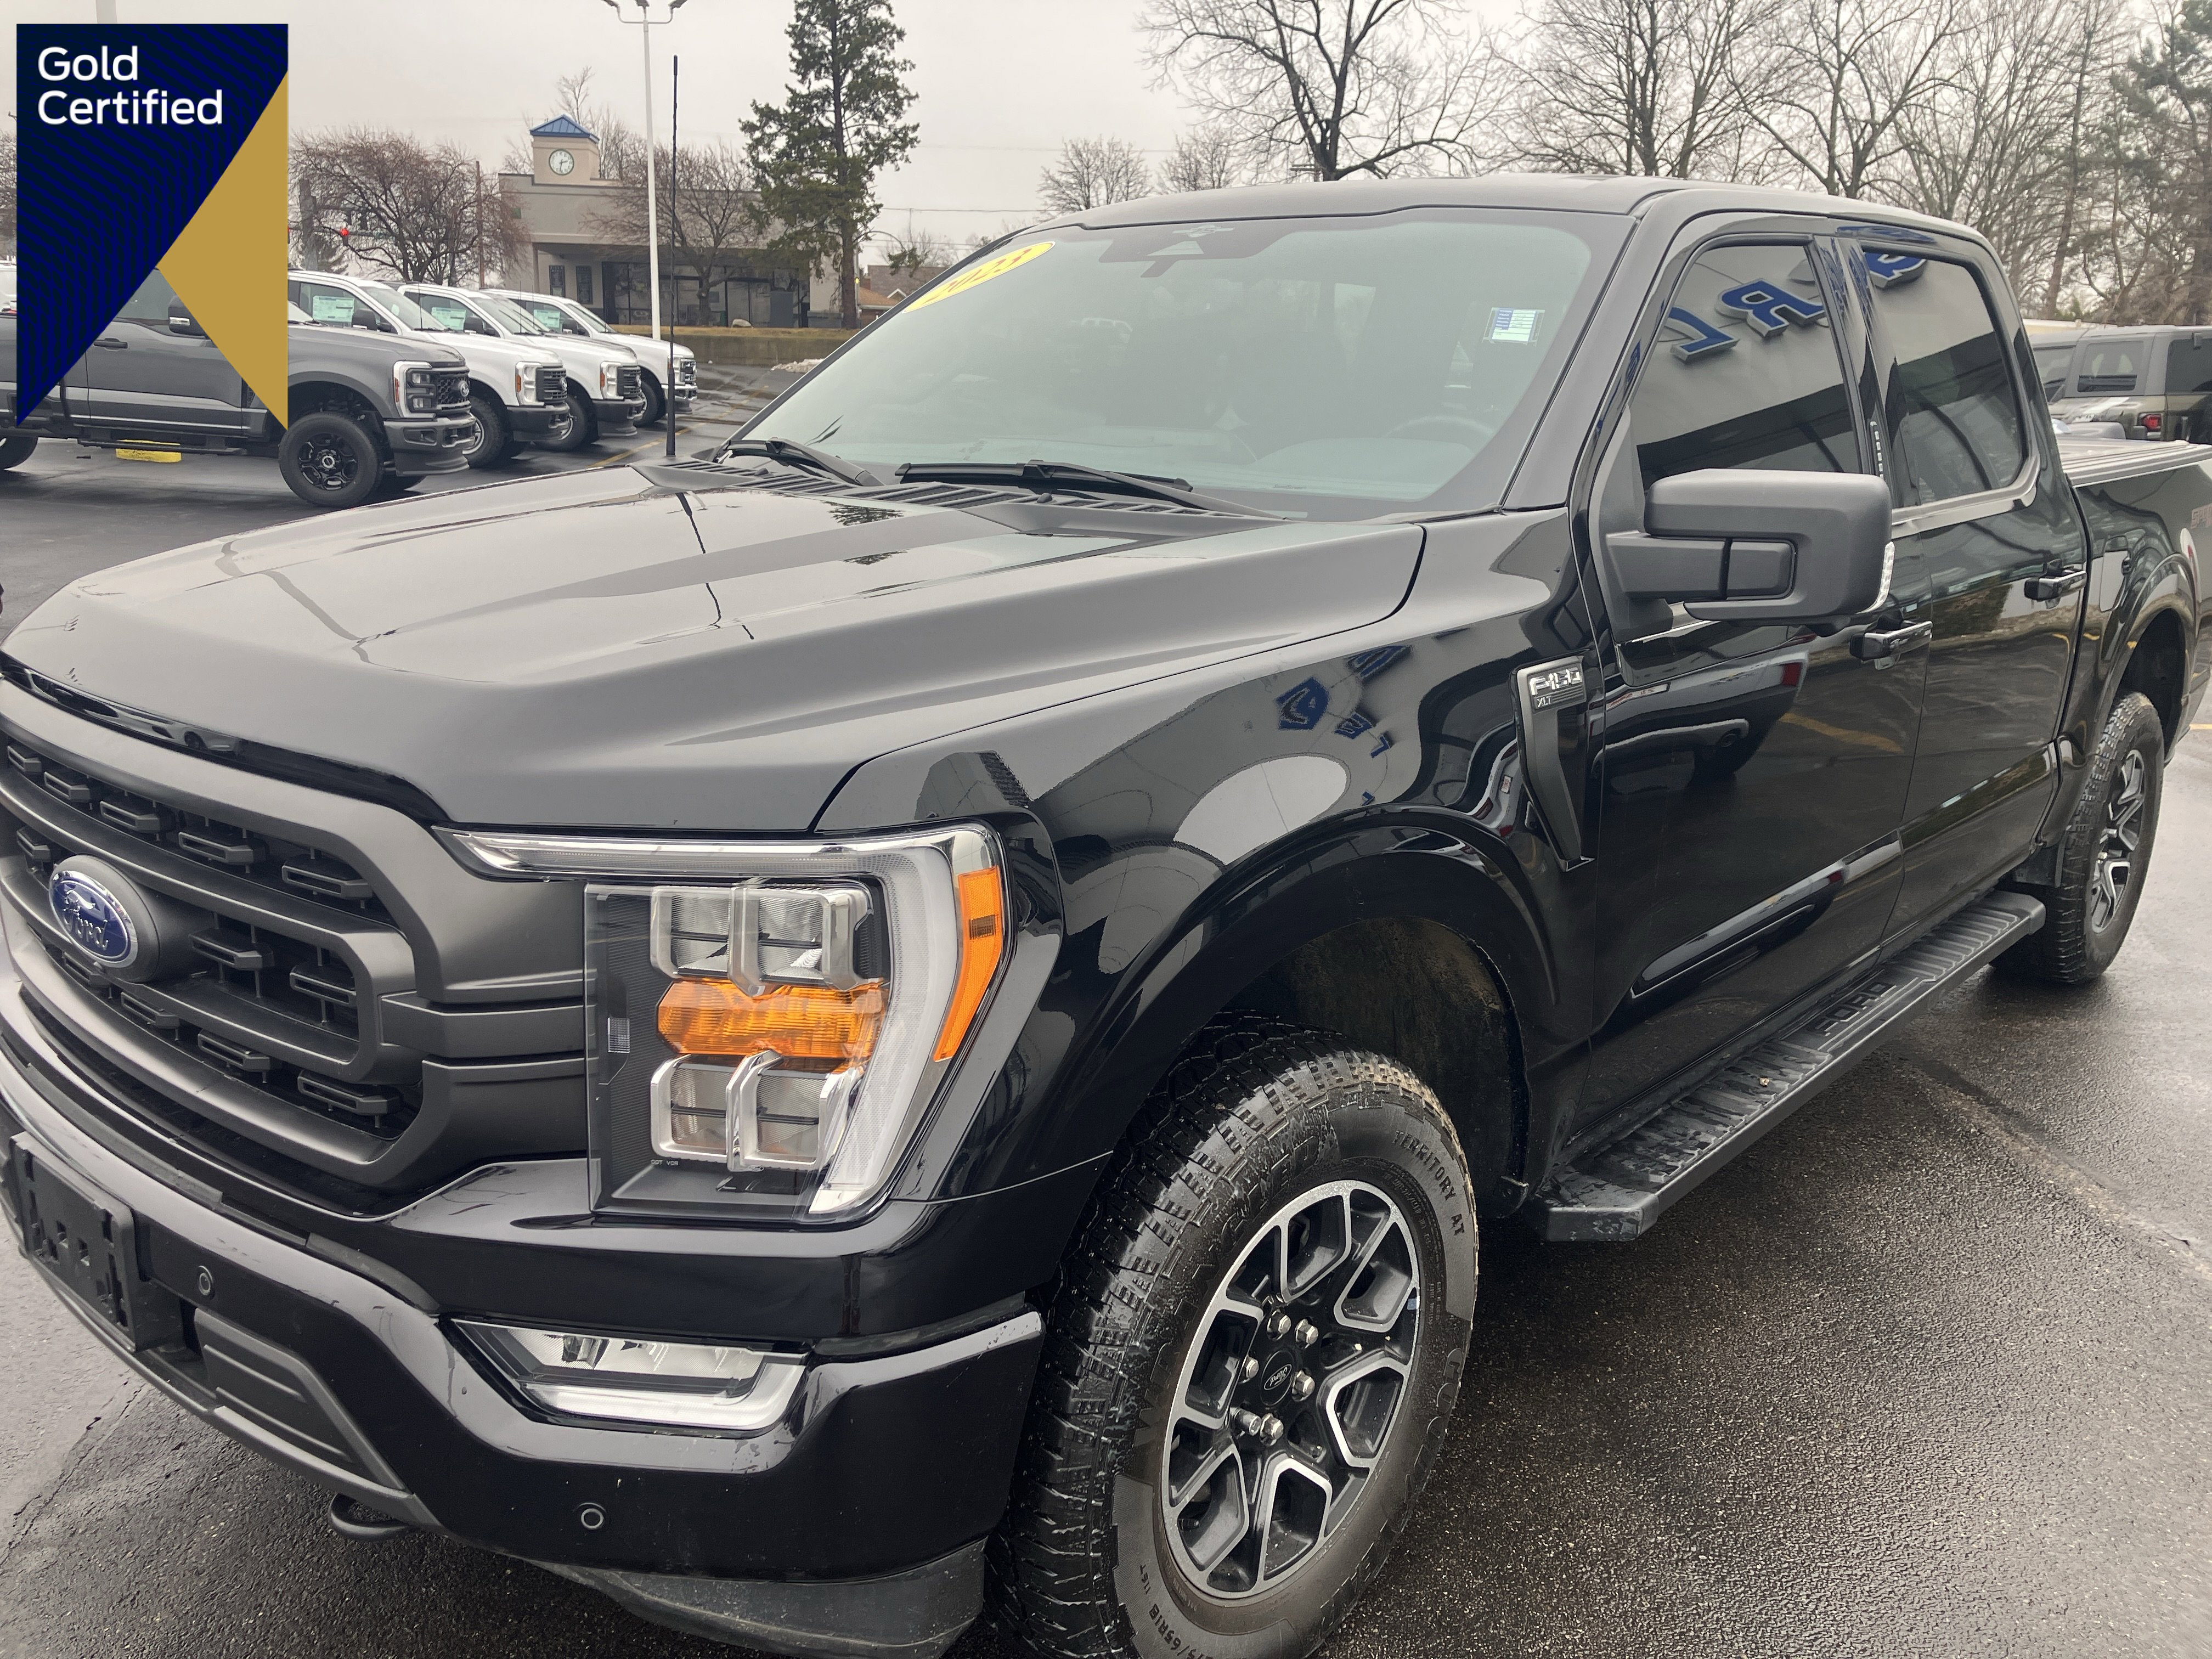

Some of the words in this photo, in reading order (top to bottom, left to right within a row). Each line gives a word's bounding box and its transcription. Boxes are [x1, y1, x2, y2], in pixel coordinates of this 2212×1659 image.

[1537, 695, 1552, 708] XLT
[61, 889, 110, 951] Ford
[1808, 981, 1897, 1036] FORD
[1392, 1130, 1456, 1201] TERRITORY
[1452, 1214, 1465, 1235] AT
[1269, 1366, 1288, 1387] Ford
[1139, 1564, 1151, 1595] 116T
